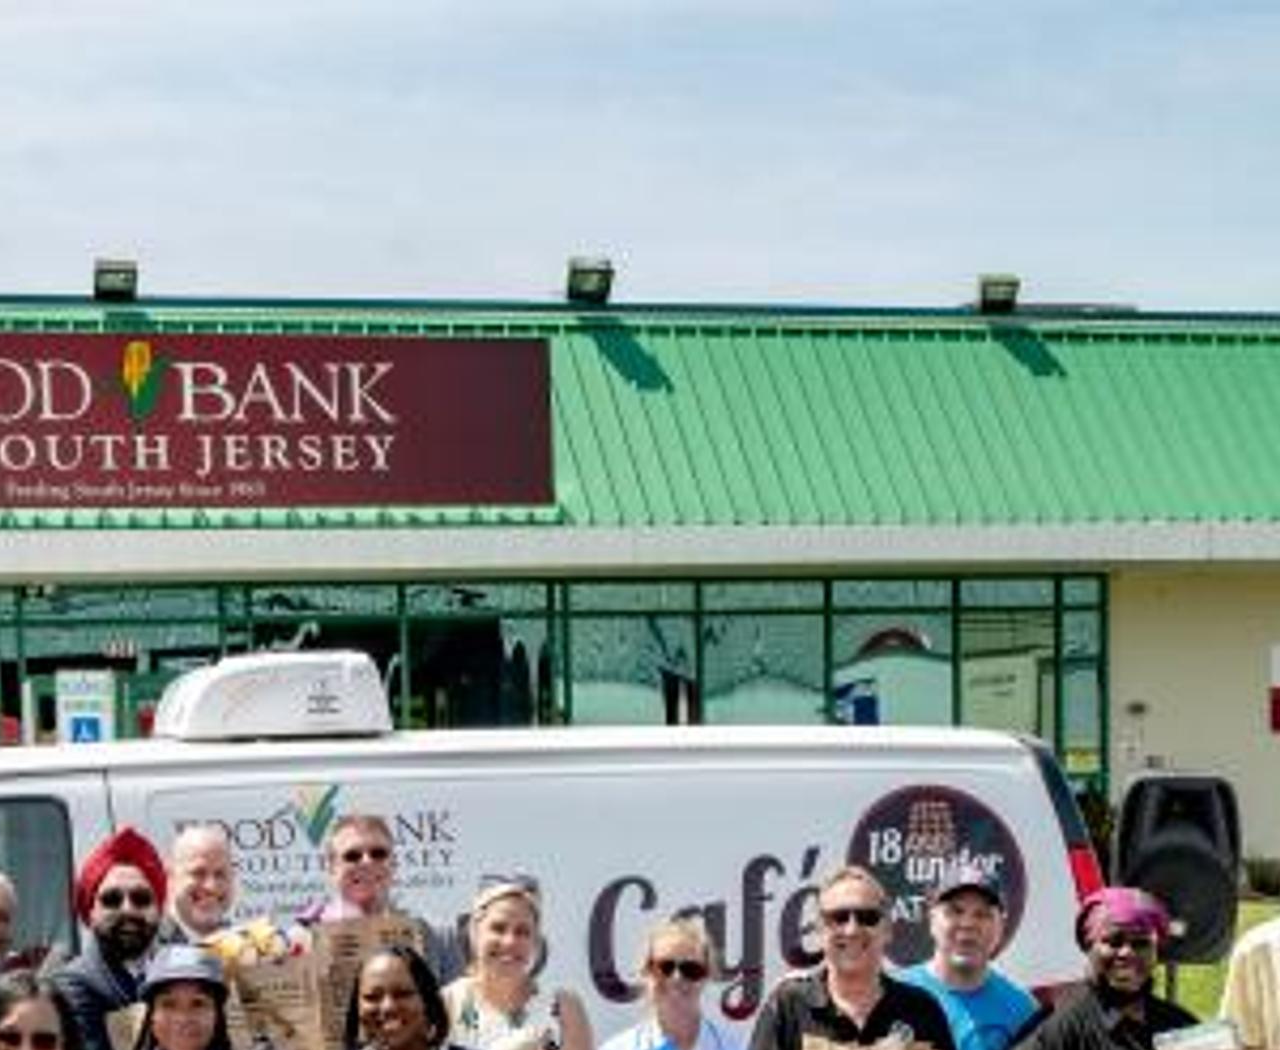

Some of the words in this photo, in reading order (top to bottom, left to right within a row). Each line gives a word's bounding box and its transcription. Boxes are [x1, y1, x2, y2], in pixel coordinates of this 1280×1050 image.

[170, 361, 396, 424] BANK
[195, 434, 396, 476] JERSEY
[869, 828, 902, 865] 18
